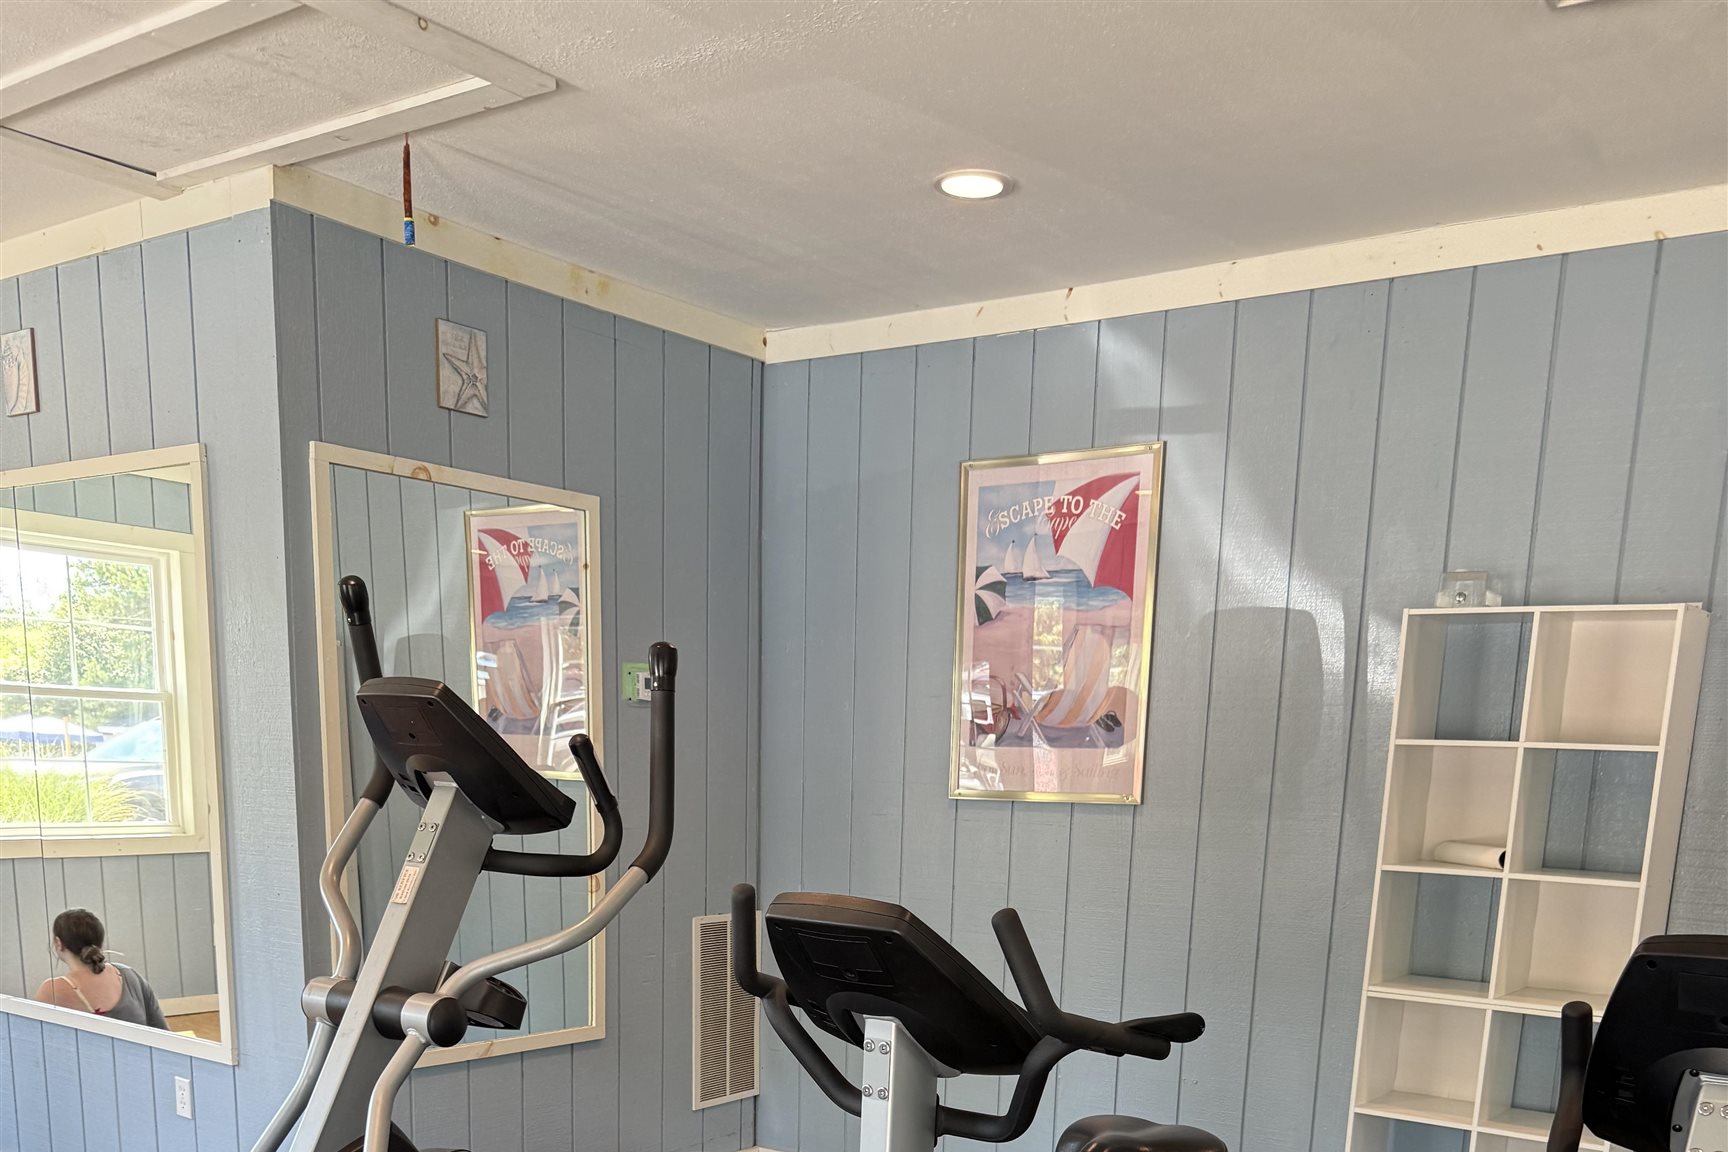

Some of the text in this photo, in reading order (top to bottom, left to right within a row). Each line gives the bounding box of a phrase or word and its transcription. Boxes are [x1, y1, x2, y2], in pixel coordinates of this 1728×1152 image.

[985, 495, 1126, 539] ESCAPE TO THE
